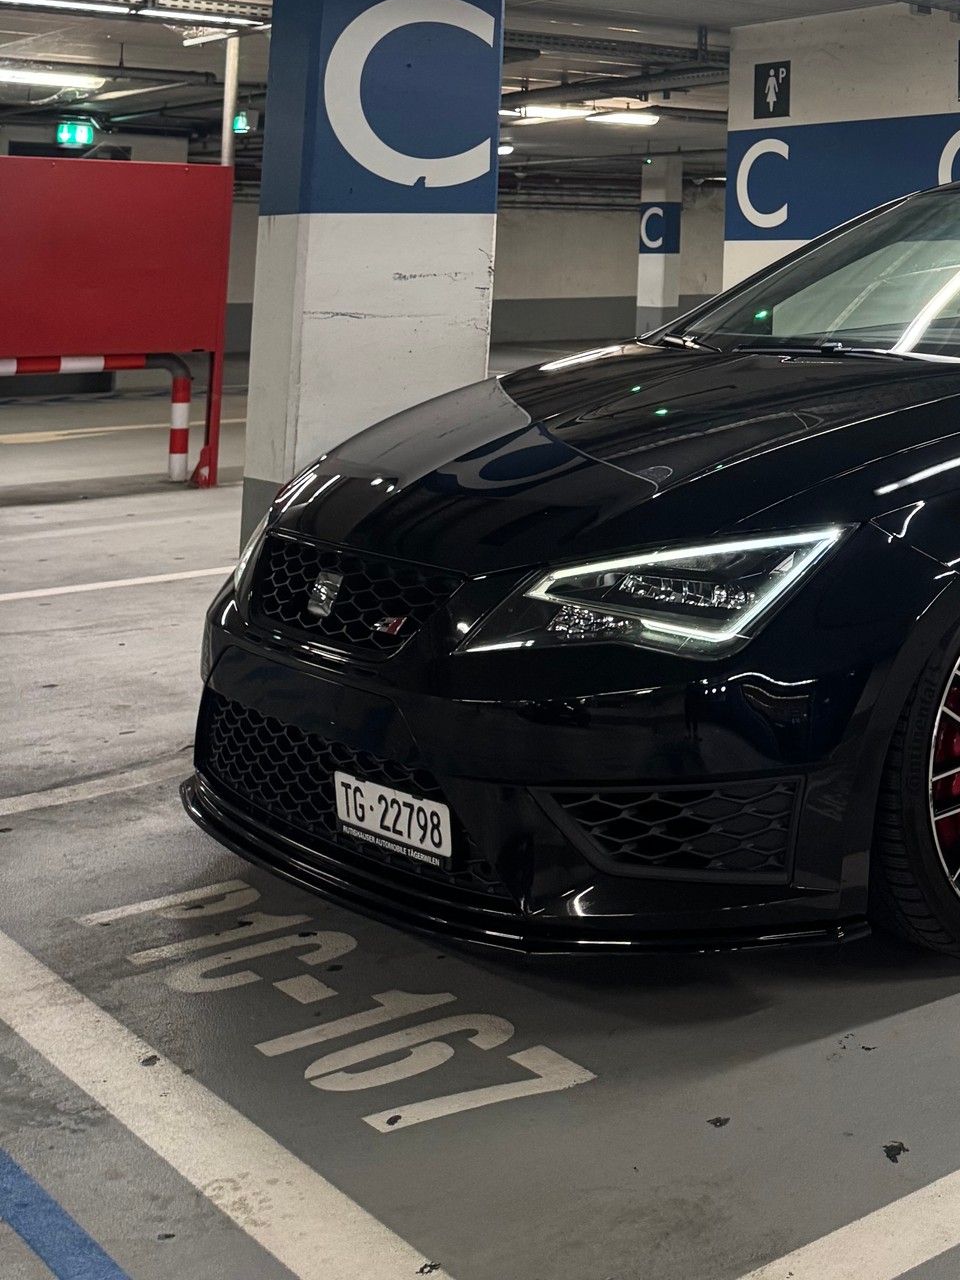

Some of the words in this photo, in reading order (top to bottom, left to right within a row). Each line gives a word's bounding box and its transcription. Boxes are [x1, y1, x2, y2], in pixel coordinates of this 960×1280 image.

[778, 67, 787, 84] P
[736, 138, 789, 228] C
[641, 207, 665, 249] C
[375, 839, 407, 856] AUTOMOBILE
